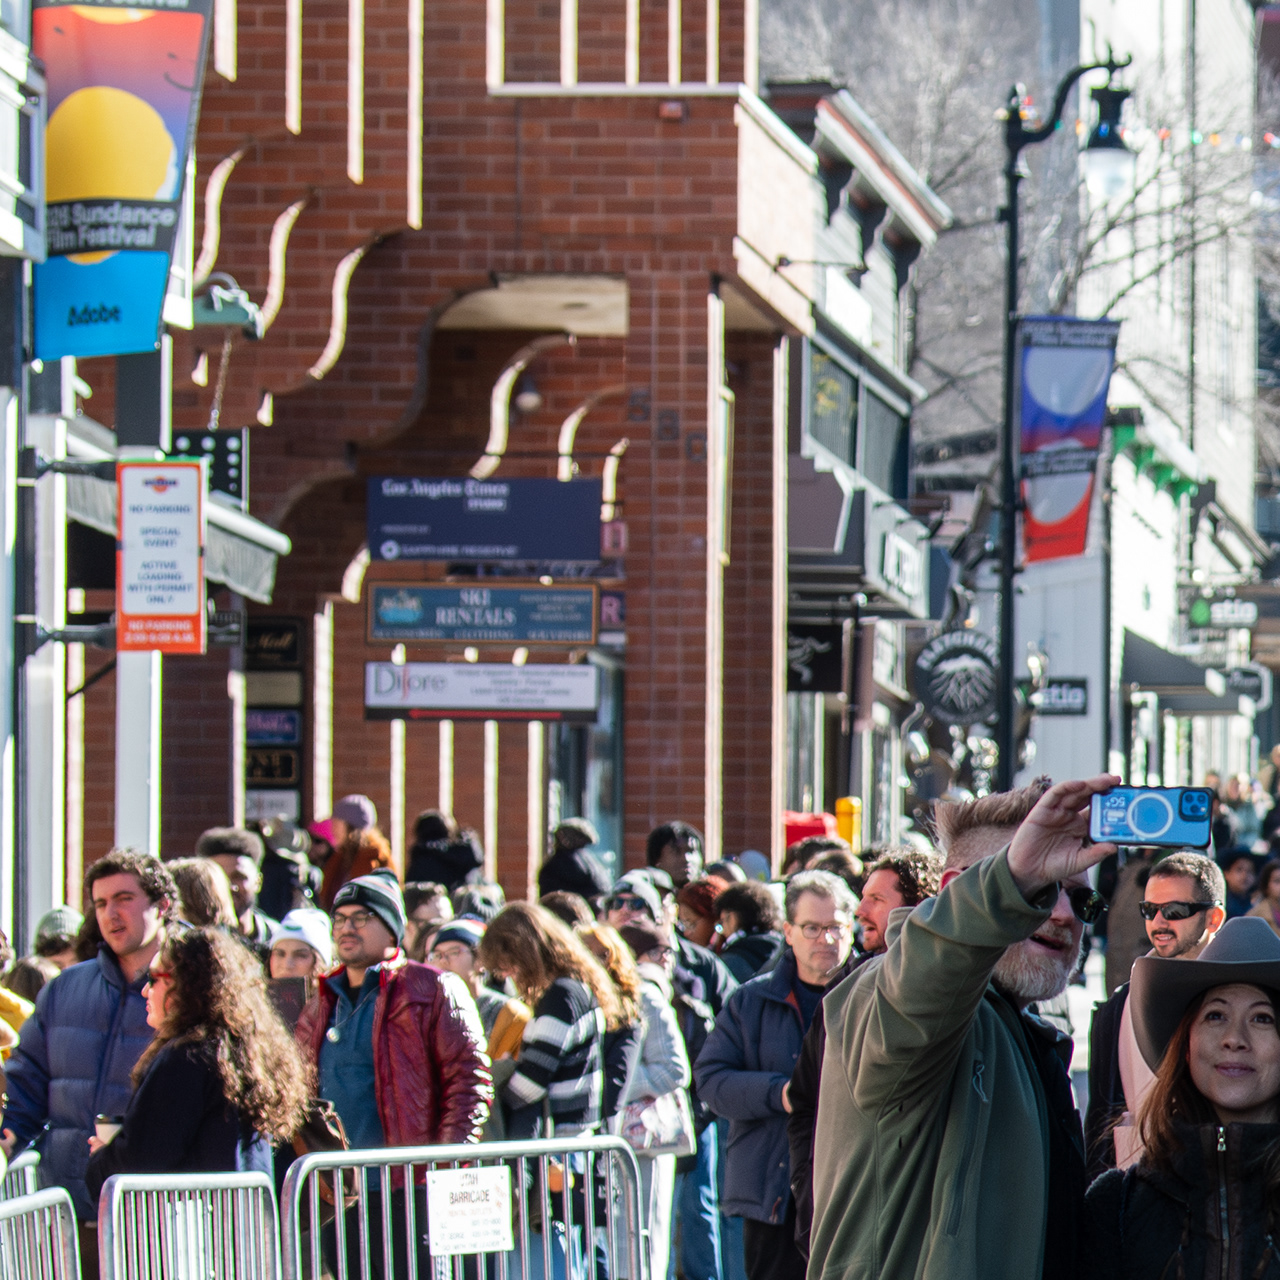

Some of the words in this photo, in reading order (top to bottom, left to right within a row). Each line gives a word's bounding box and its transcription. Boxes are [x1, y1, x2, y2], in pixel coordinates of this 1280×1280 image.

[72, 201, 177, 228] Sundance
[78, 223, 156, 248] Festival
[67, 303, 121, 327] Adobe
[382, 478, 407, 497] Los
[409, 478, 462, 500] Angeles
[464, 478, 509, 498] Times
[459, 588, 491, 606] SKI
[435, 607, 517, 626] RENTALS
[1210, 598, 1258, 622] stio
[460, 1173, 479, 1186] UTAH
[448, 1189, 490, 1205] BARRICADE
